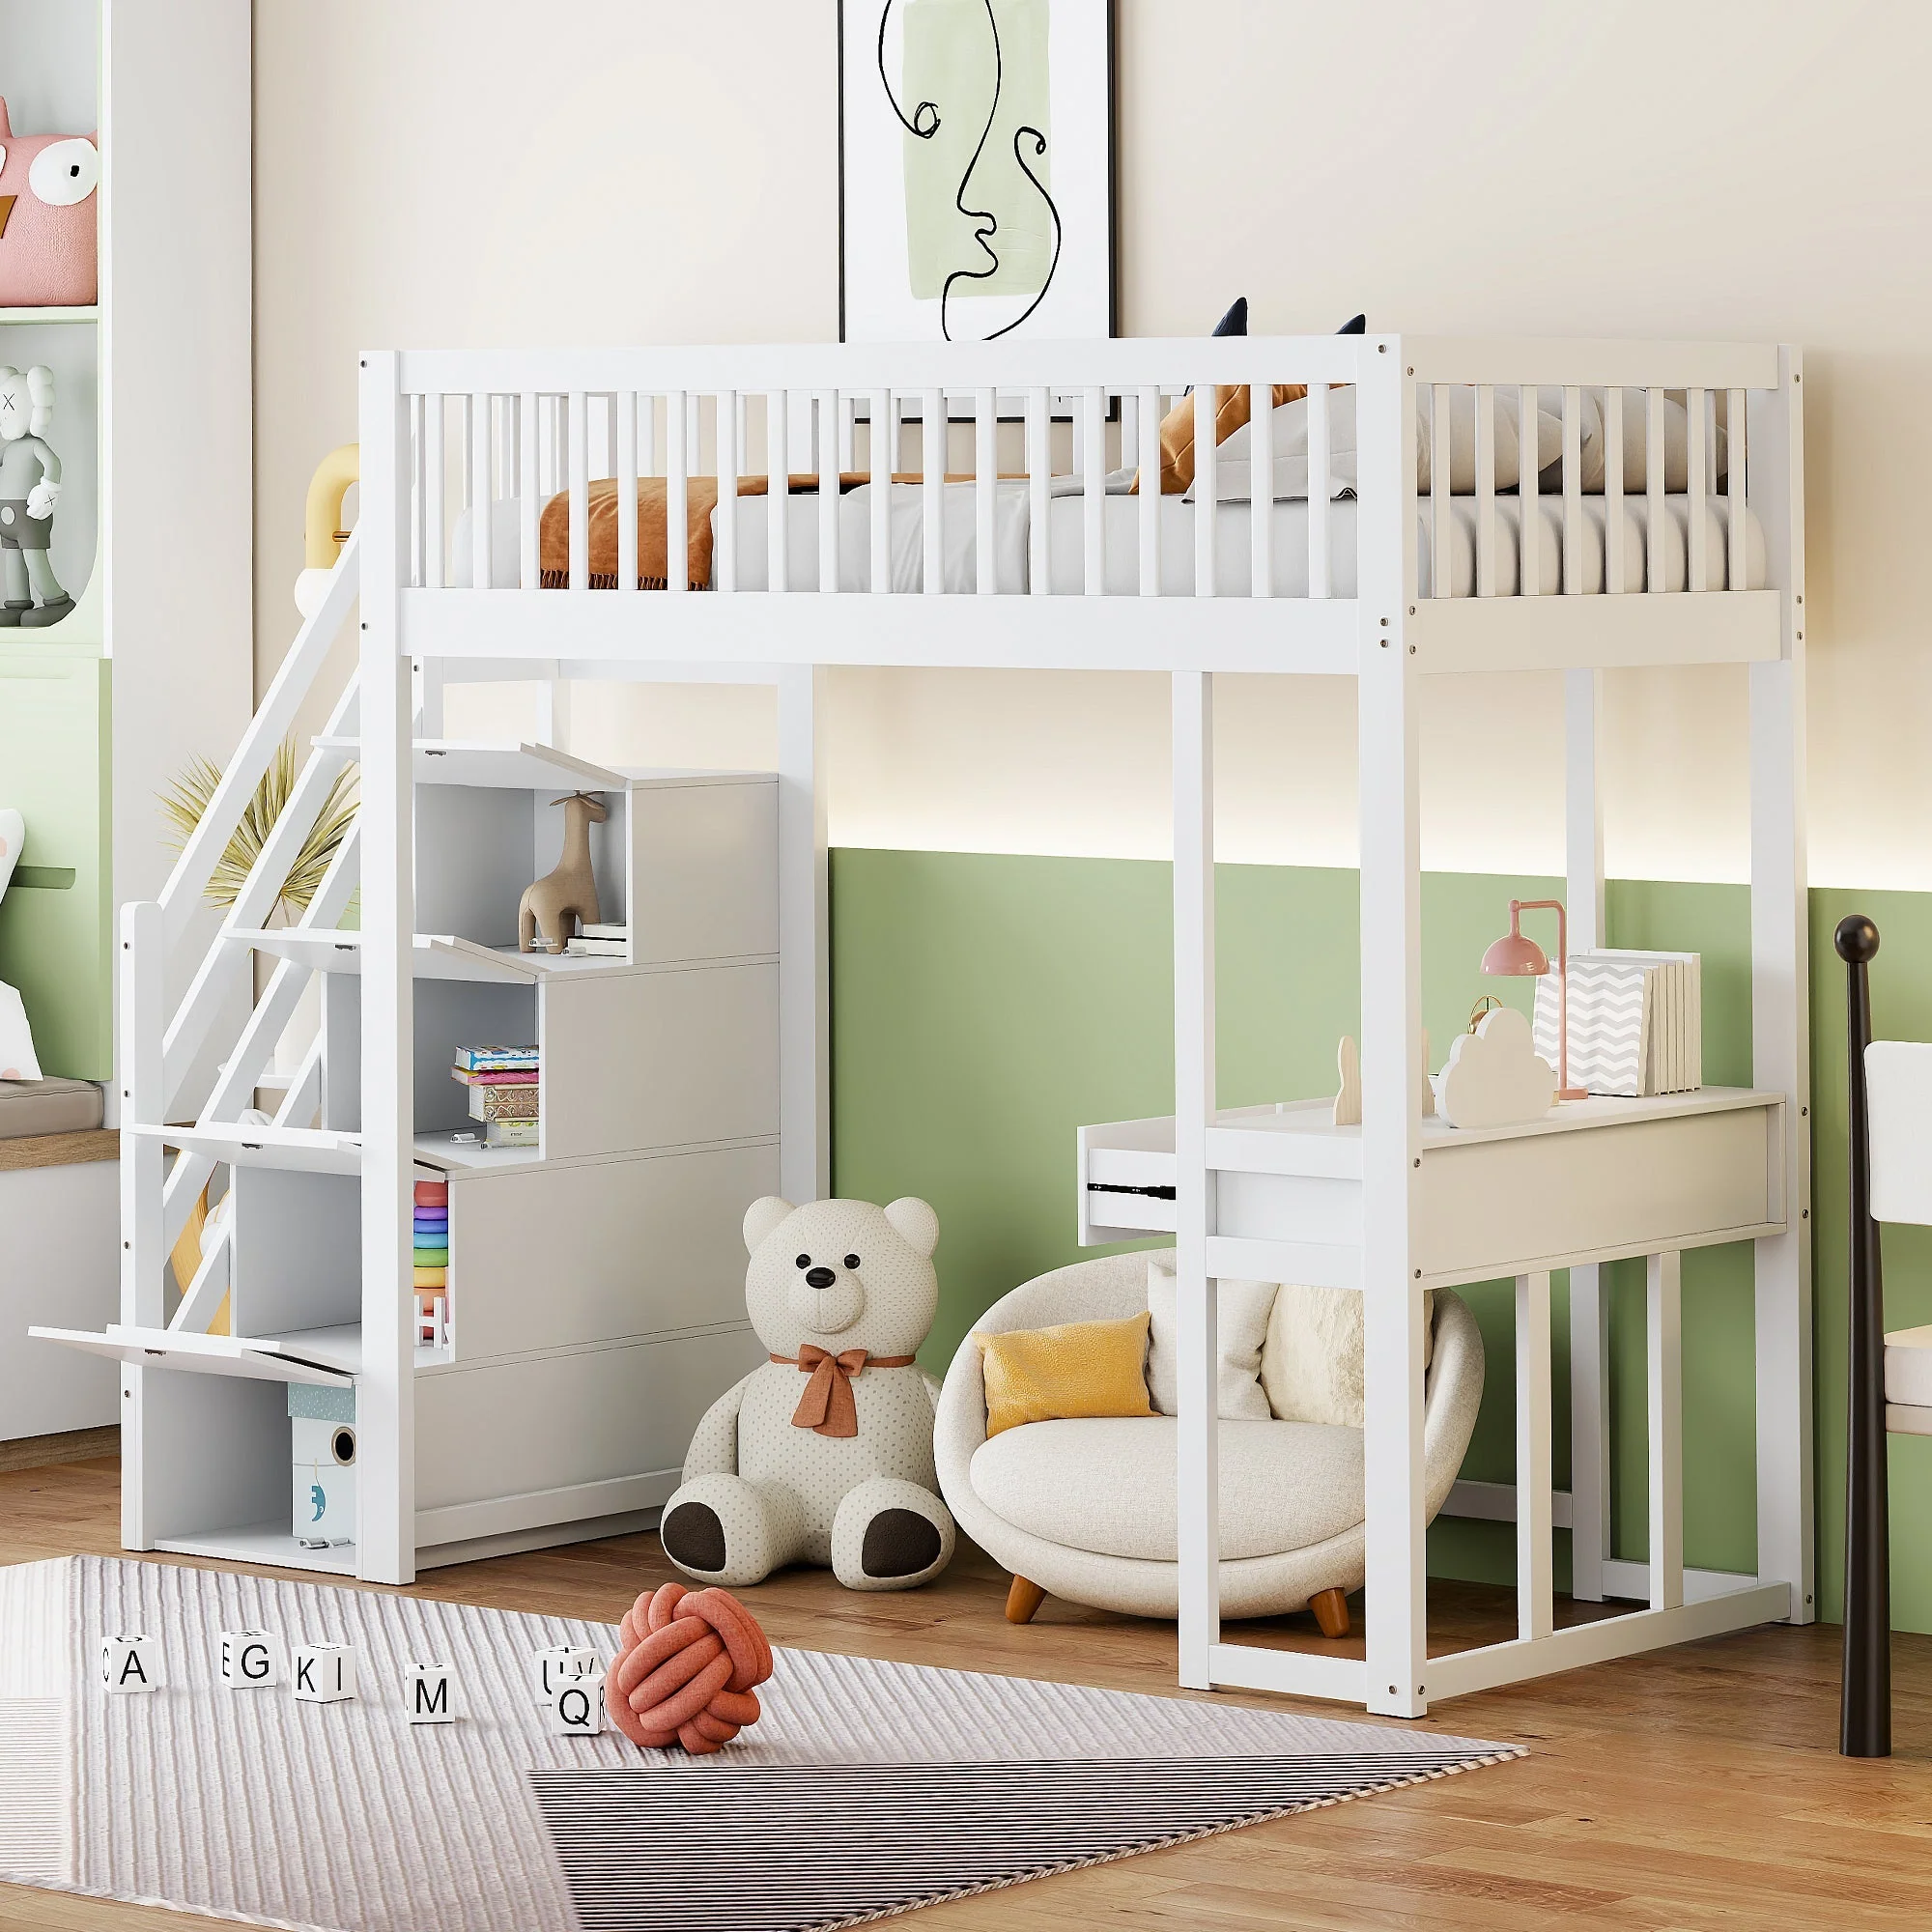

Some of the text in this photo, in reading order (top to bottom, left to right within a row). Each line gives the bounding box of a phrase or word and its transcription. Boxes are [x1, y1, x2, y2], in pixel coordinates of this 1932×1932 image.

[102, 1647, 109, 1683] C
[119, 1650, 148, 1685] A
[222, 1641, 230, 1678] E
[241, 1643, 270, 1680] G
[297, 1656, 316, 1692] K
[415, 1678, 447, 1714] M
[558, 1689, 590, 1727] Q
